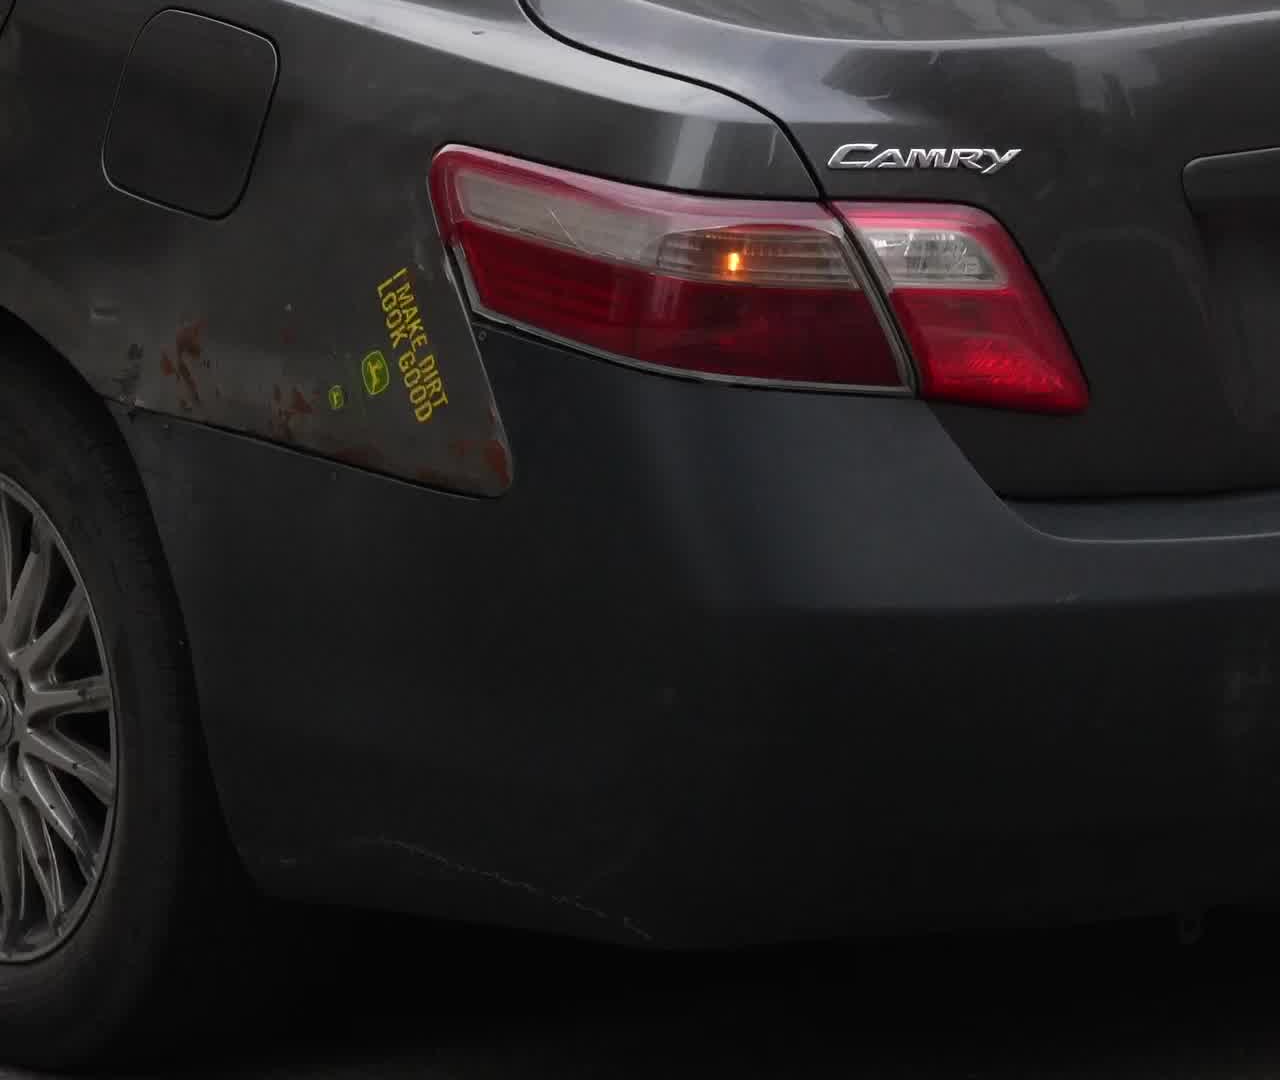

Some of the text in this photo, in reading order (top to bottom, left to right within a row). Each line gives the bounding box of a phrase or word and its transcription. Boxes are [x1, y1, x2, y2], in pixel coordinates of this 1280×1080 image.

[826, 142, 1022, 175] CAMRY
[376, 277, 434, 423] LOOK GOOD
[394, 281, 429, 353] MAKE
[418, 353, 450, 409] DIRT
